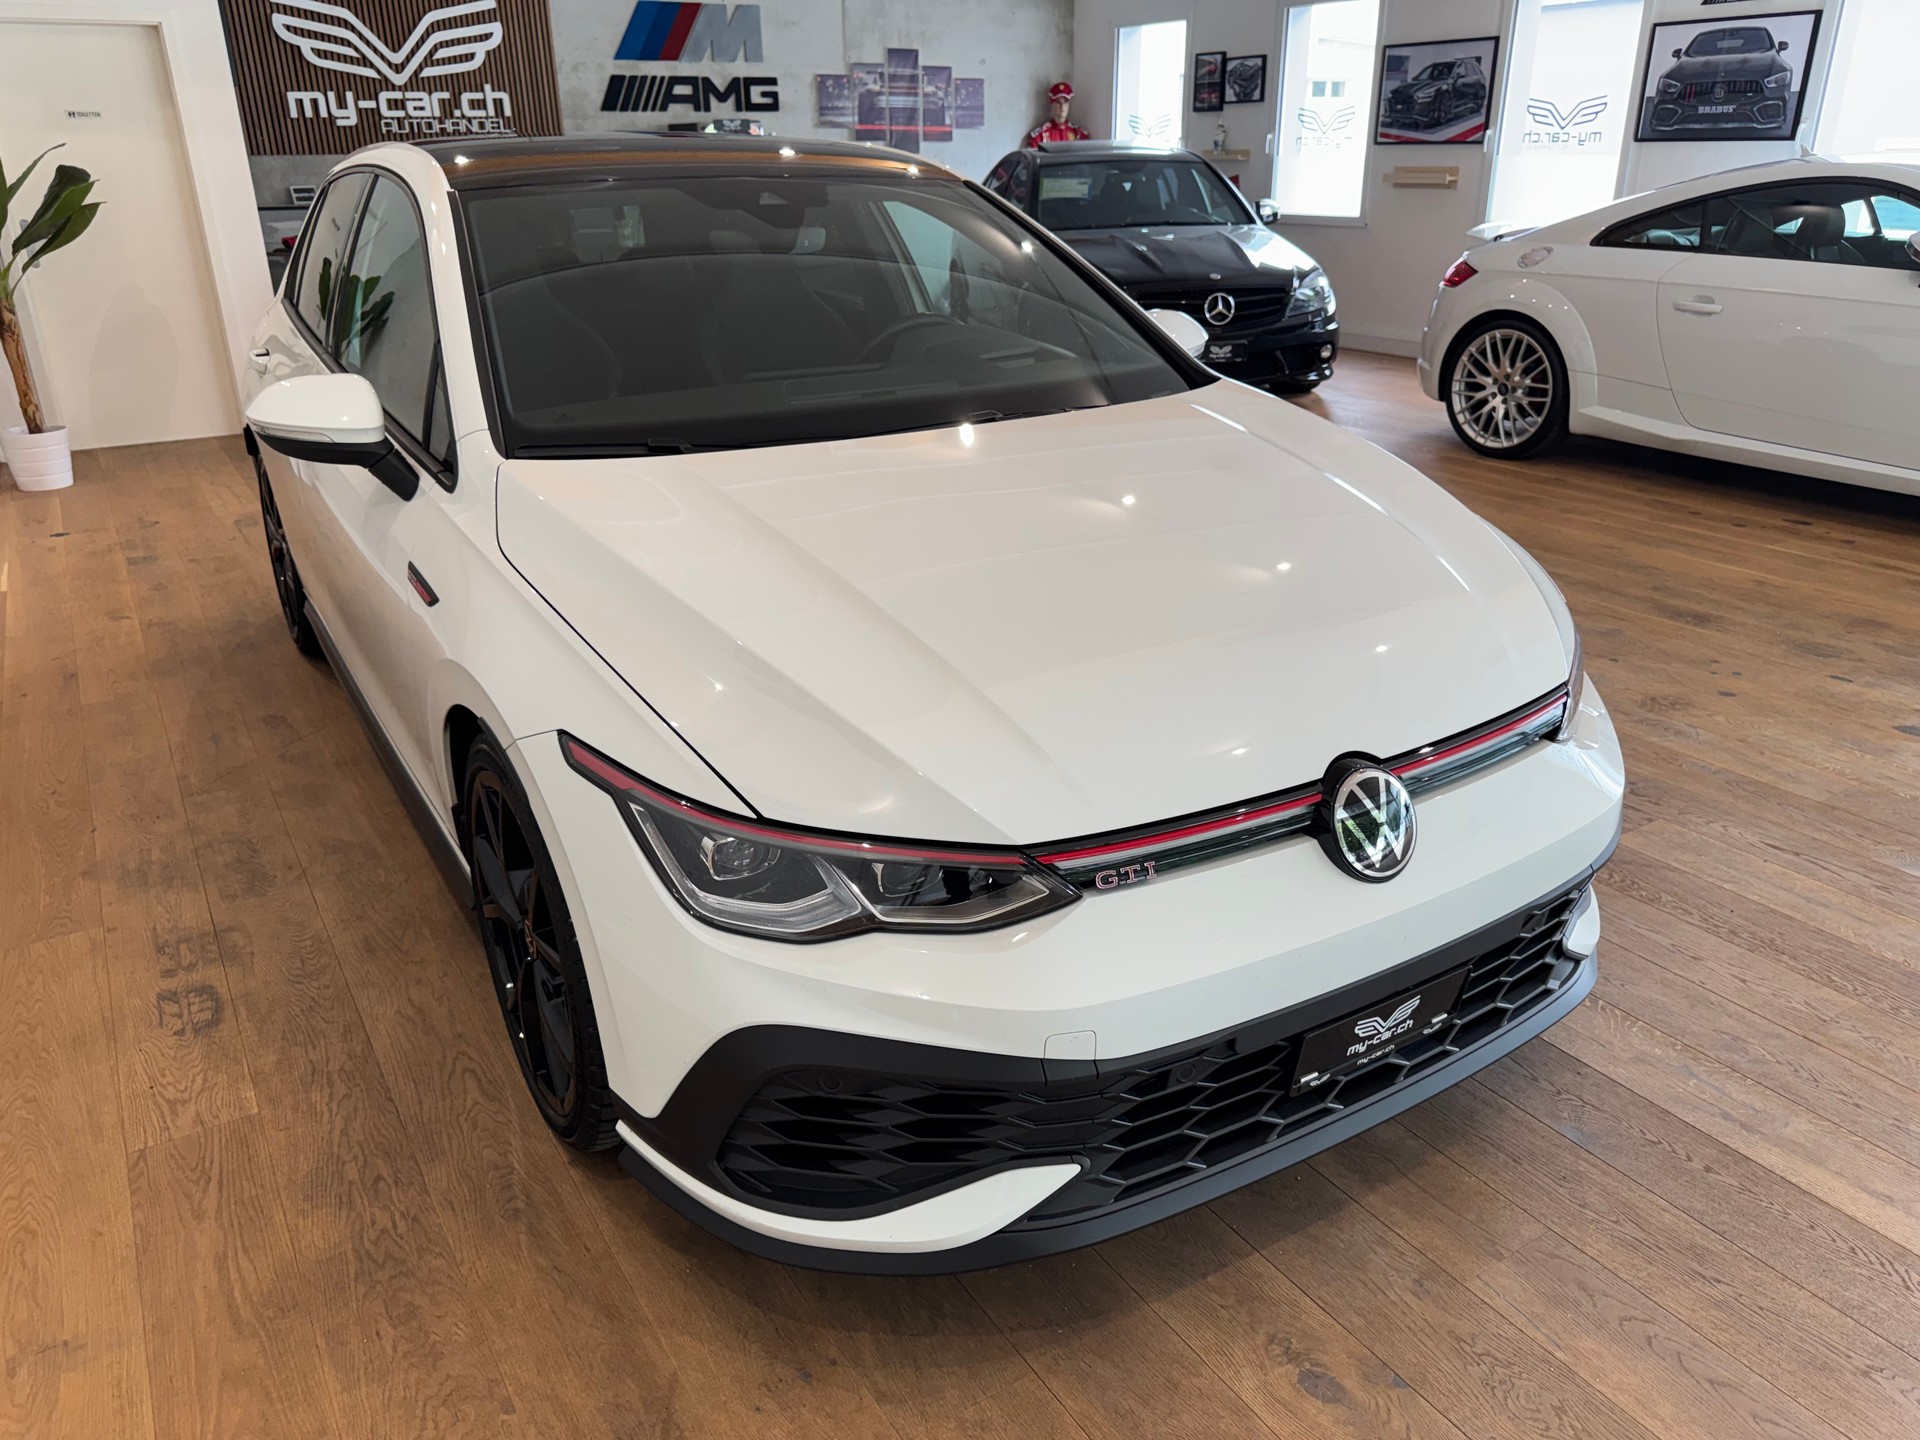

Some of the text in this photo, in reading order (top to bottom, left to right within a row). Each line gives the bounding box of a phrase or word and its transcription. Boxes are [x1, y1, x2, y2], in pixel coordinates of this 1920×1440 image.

[286, 84, 512, 126] my-car.ch
[658, 75, 780, 112] AMG
[1697, 105, 1736, 114] BRABUS
[380, 118, 513, 135] AUTOHANDEL
[1095, 861, 1157, 890] GTI
[1346, 1018, 1414, 1056] my-car.ch
[1356, 1044, 1395, 1066] my-car.ch
